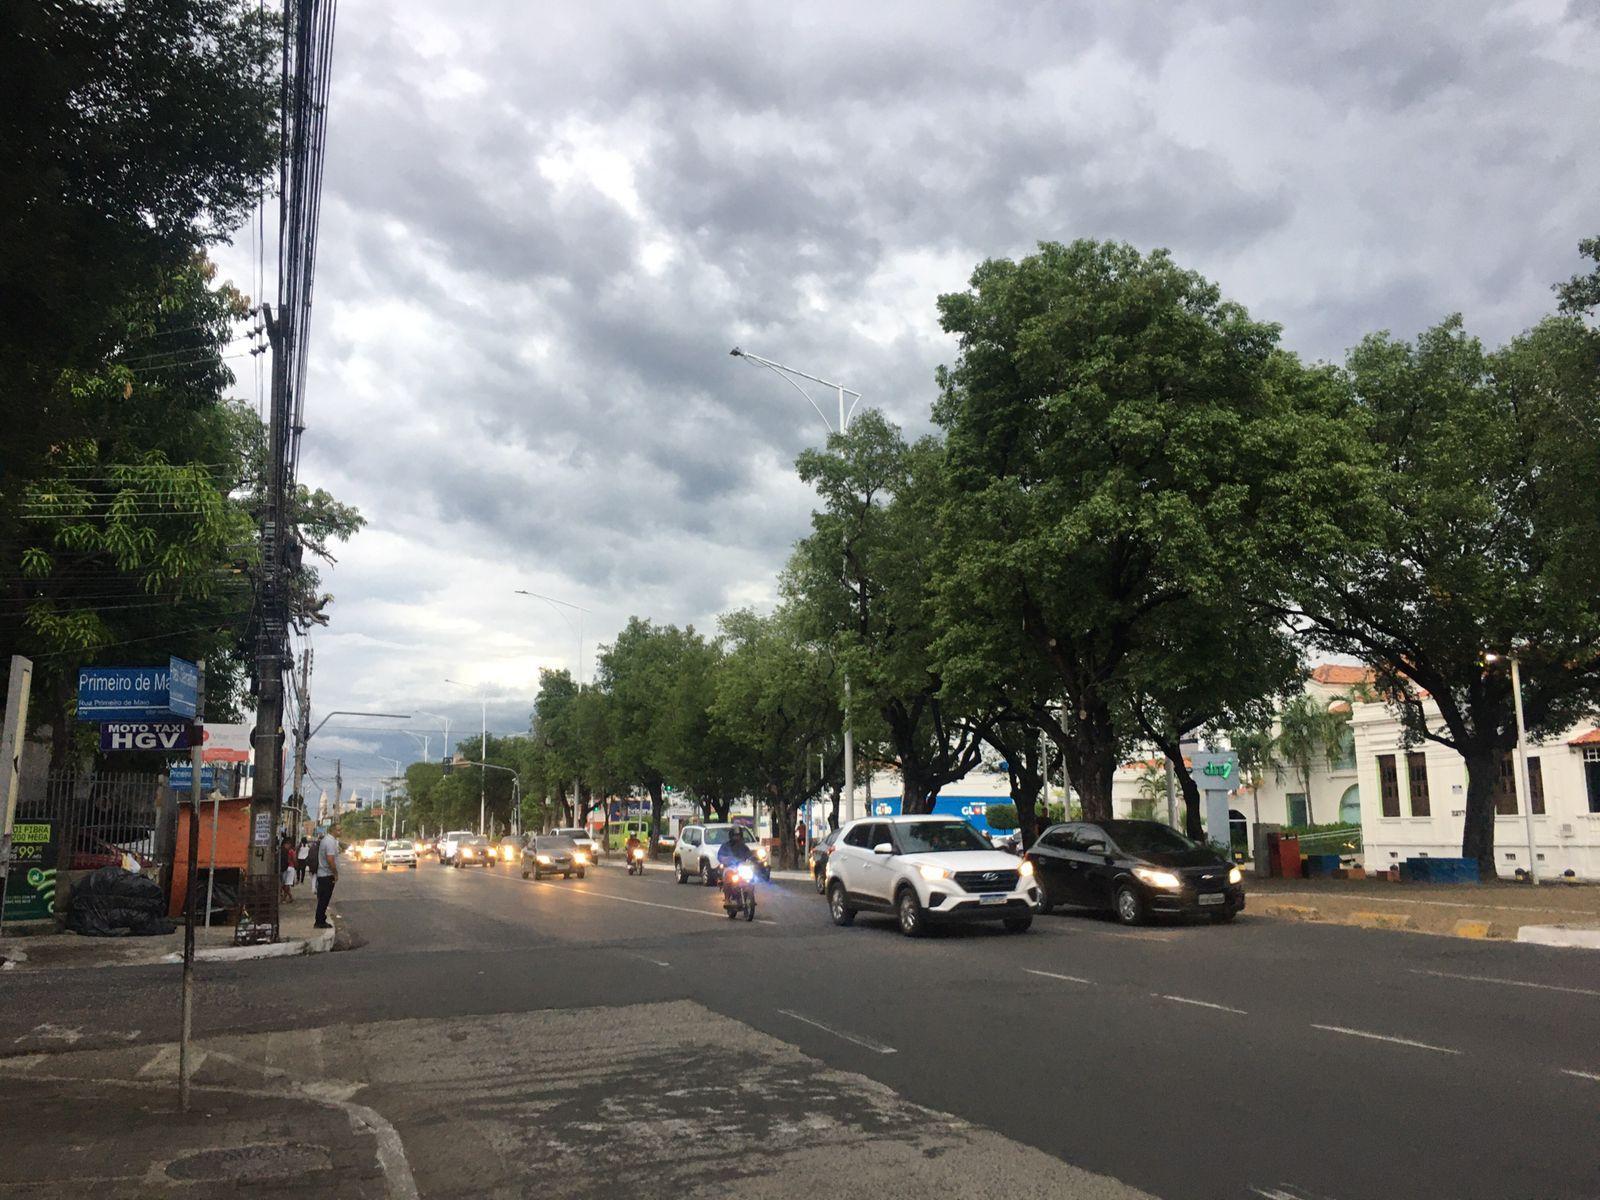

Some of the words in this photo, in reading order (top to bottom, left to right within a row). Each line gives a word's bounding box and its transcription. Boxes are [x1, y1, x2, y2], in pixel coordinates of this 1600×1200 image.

[79, 673, 132, 690] Primeiro
[135, 673, 150, 691] de
[108, 724, 149, 733] MOTO
[153, 724, 185, 733] TAXI
[112, 733, 180, 749] HGV
[24, 826, 49, 834] FIBRA
